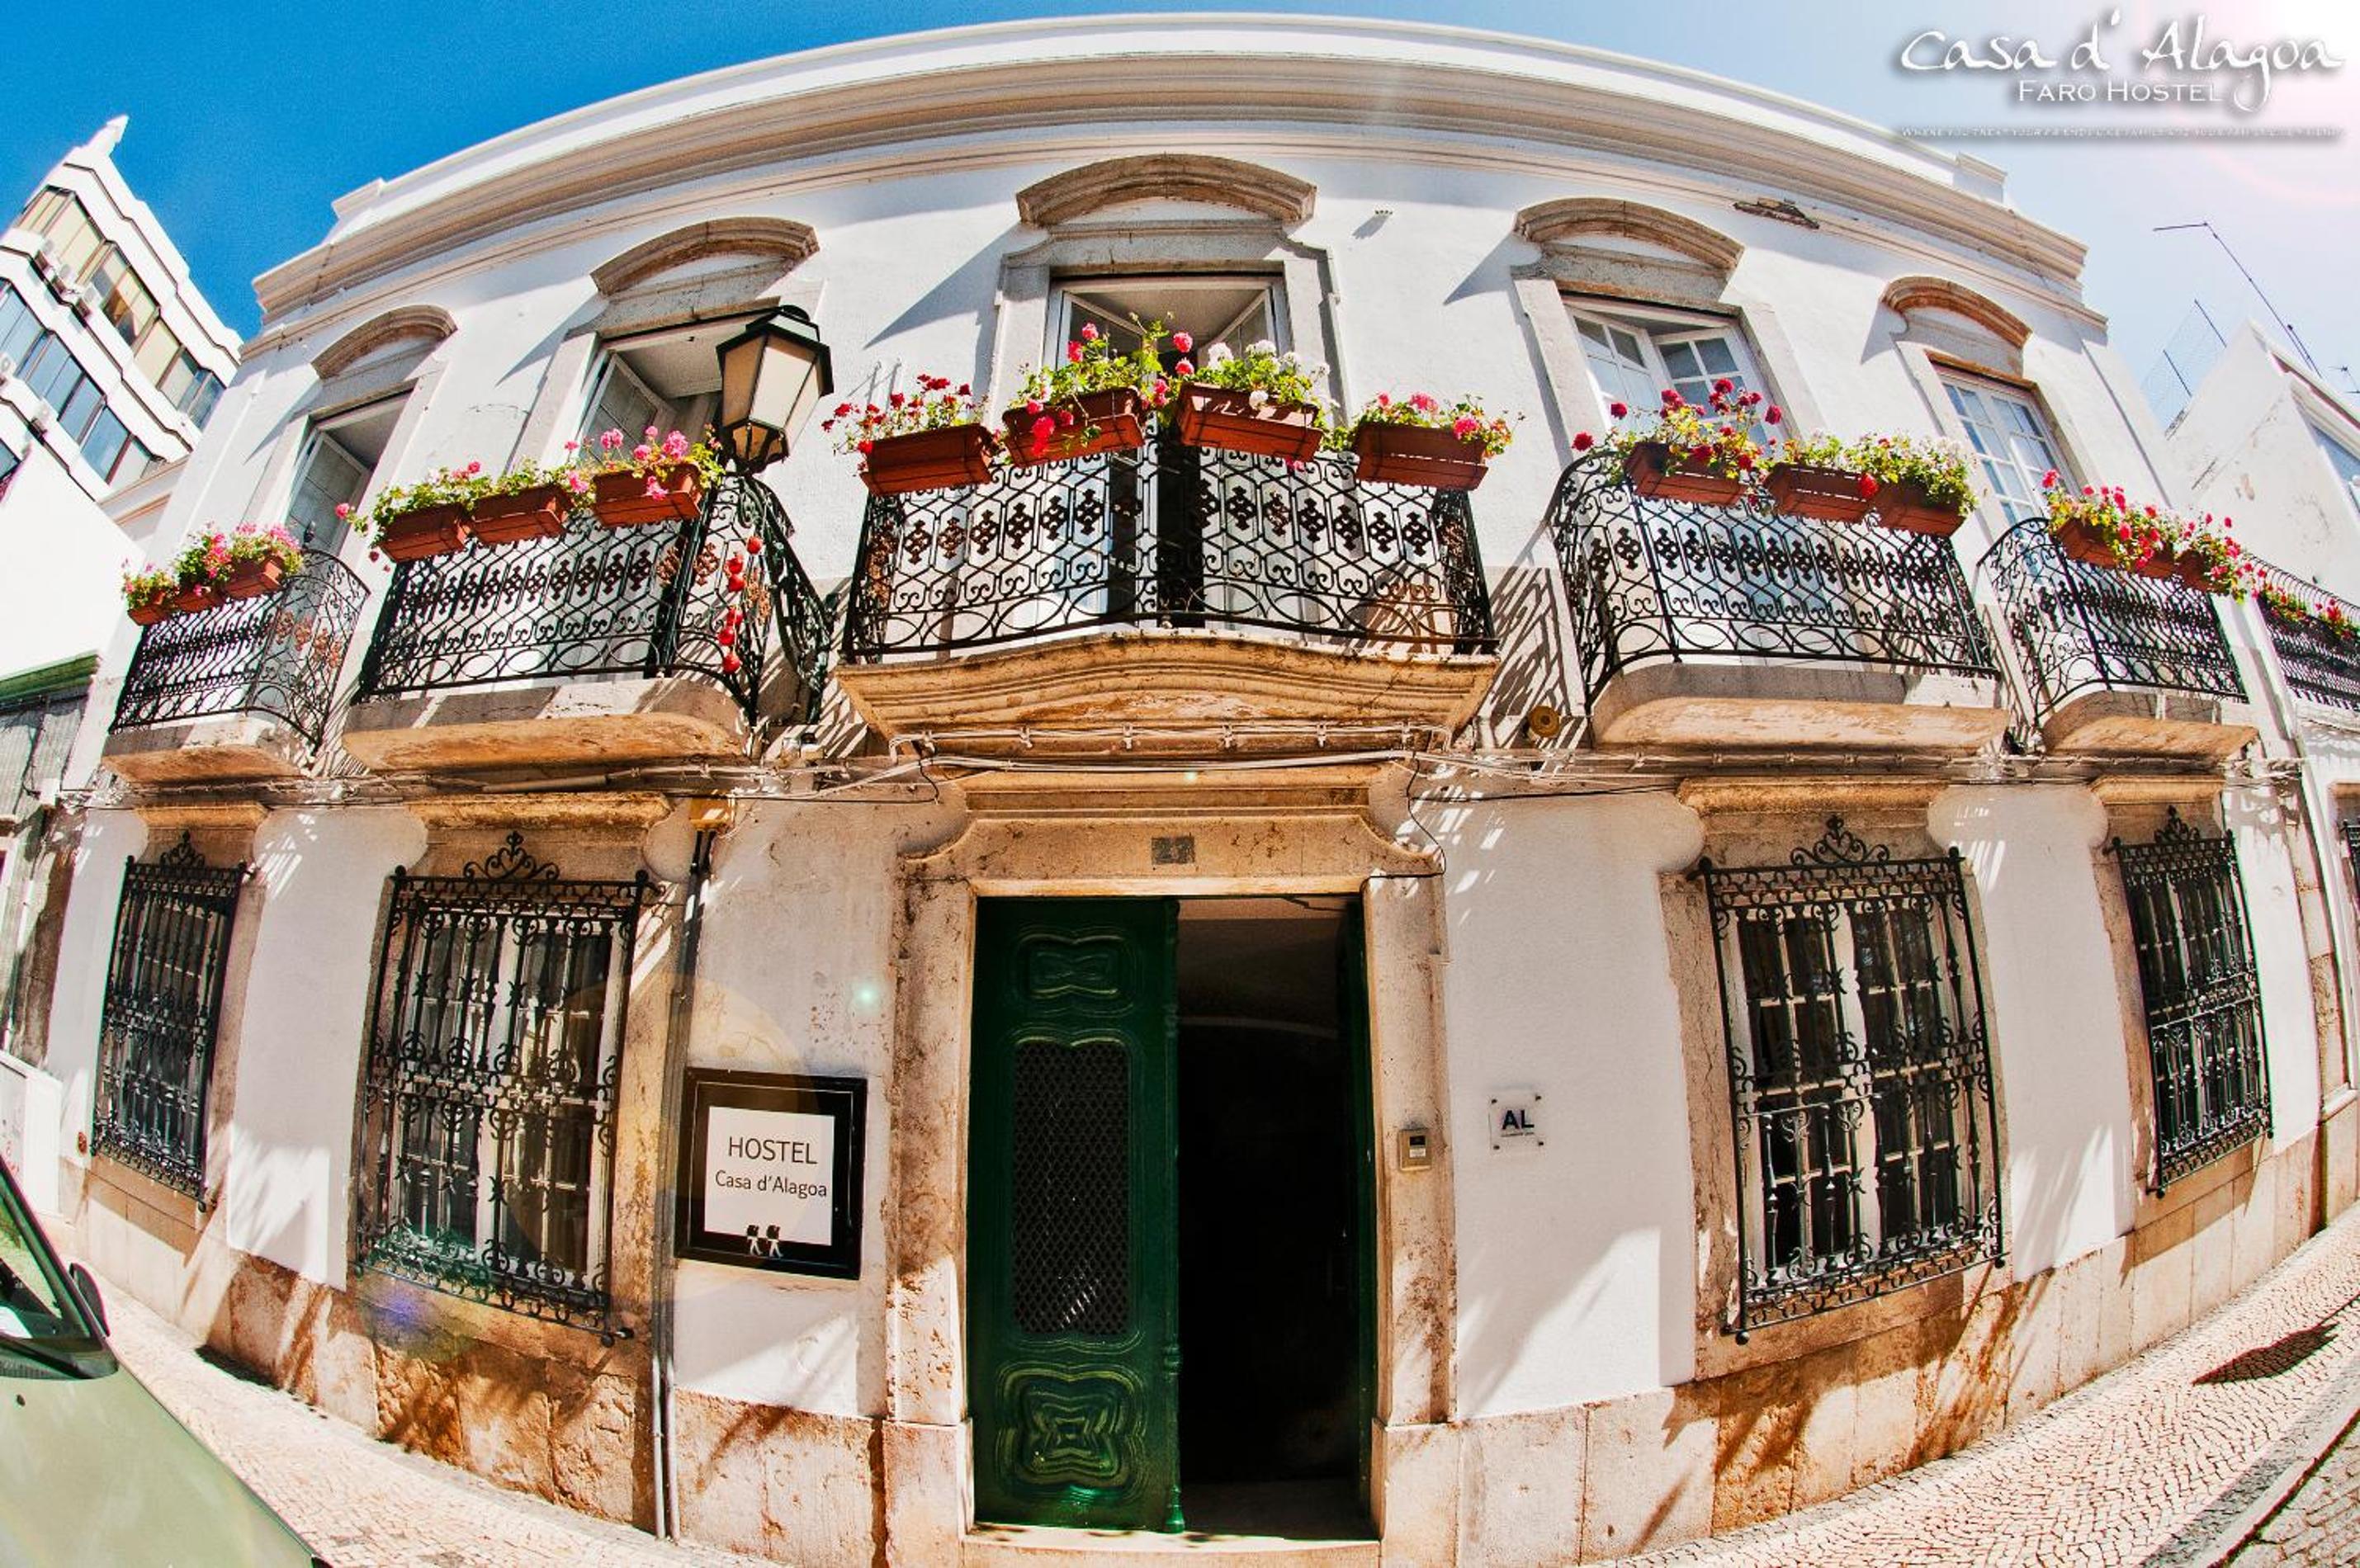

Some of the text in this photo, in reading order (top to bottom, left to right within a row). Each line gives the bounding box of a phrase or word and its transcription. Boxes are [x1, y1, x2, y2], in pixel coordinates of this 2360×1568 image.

[1502, 1109, 1535, 1130] AL
[728, 1136, 818, 1165] HOSTEL
[715, 1169, 827, 1199] Casa d'Alagoa
